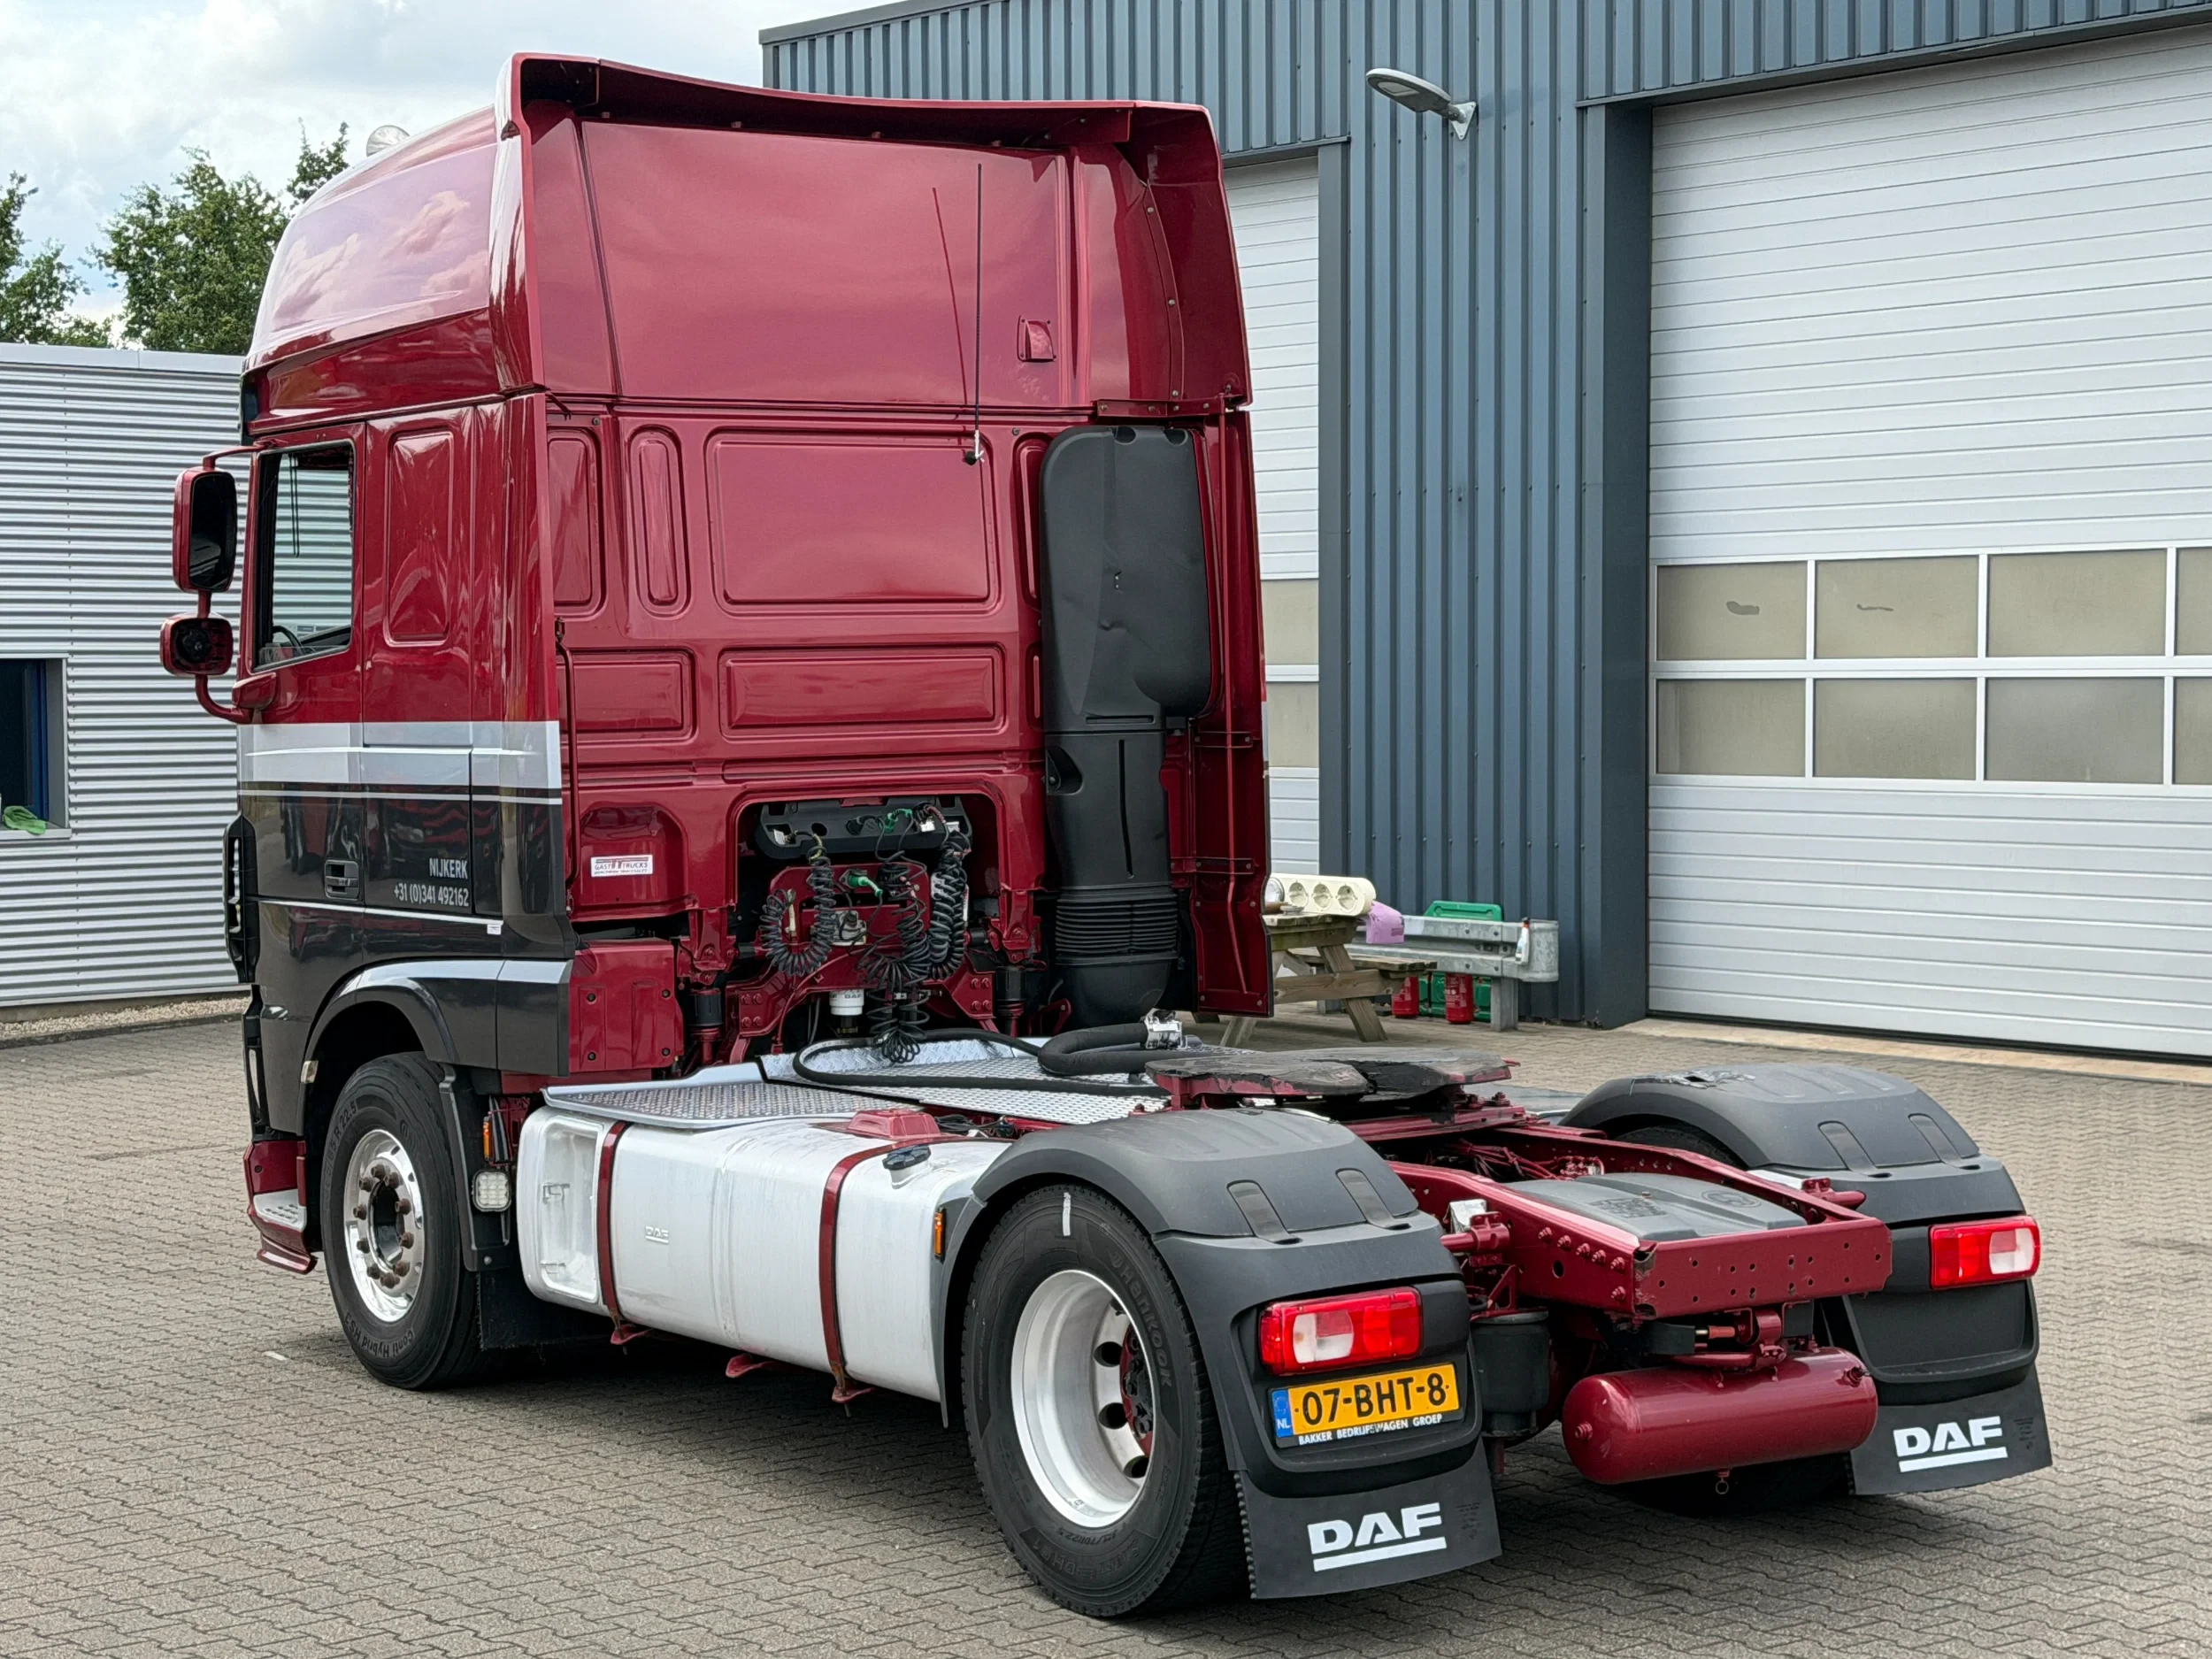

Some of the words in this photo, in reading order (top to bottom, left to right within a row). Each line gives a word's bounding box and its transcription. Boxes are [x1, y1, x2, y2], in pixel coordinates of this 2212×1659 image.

[429, 857, 468, 879] NIJKERK
[394, 882, 408, 902] +31
[410, 883, 436, 905] (0)341
[438, 886, 469, 907] 492162
[362, 1335, 389, 1358] Hybrid
[392, 1330, 414, 1357] Conti
[1302, 1372, 1447, 1425] 07-BHT-8
[1277, 1417, 1291, 1429] NL
[1298, 1431, 1333, 1446] BAKKER
[1336, 1421, 1409, 1439] BEDRIJFSWAGEN
[1412, 1413, 1443, 1426] GROEP
[1893, 1416, 2003, 1457] DAF
[1307, 1502, 1443, 1555] DAF
